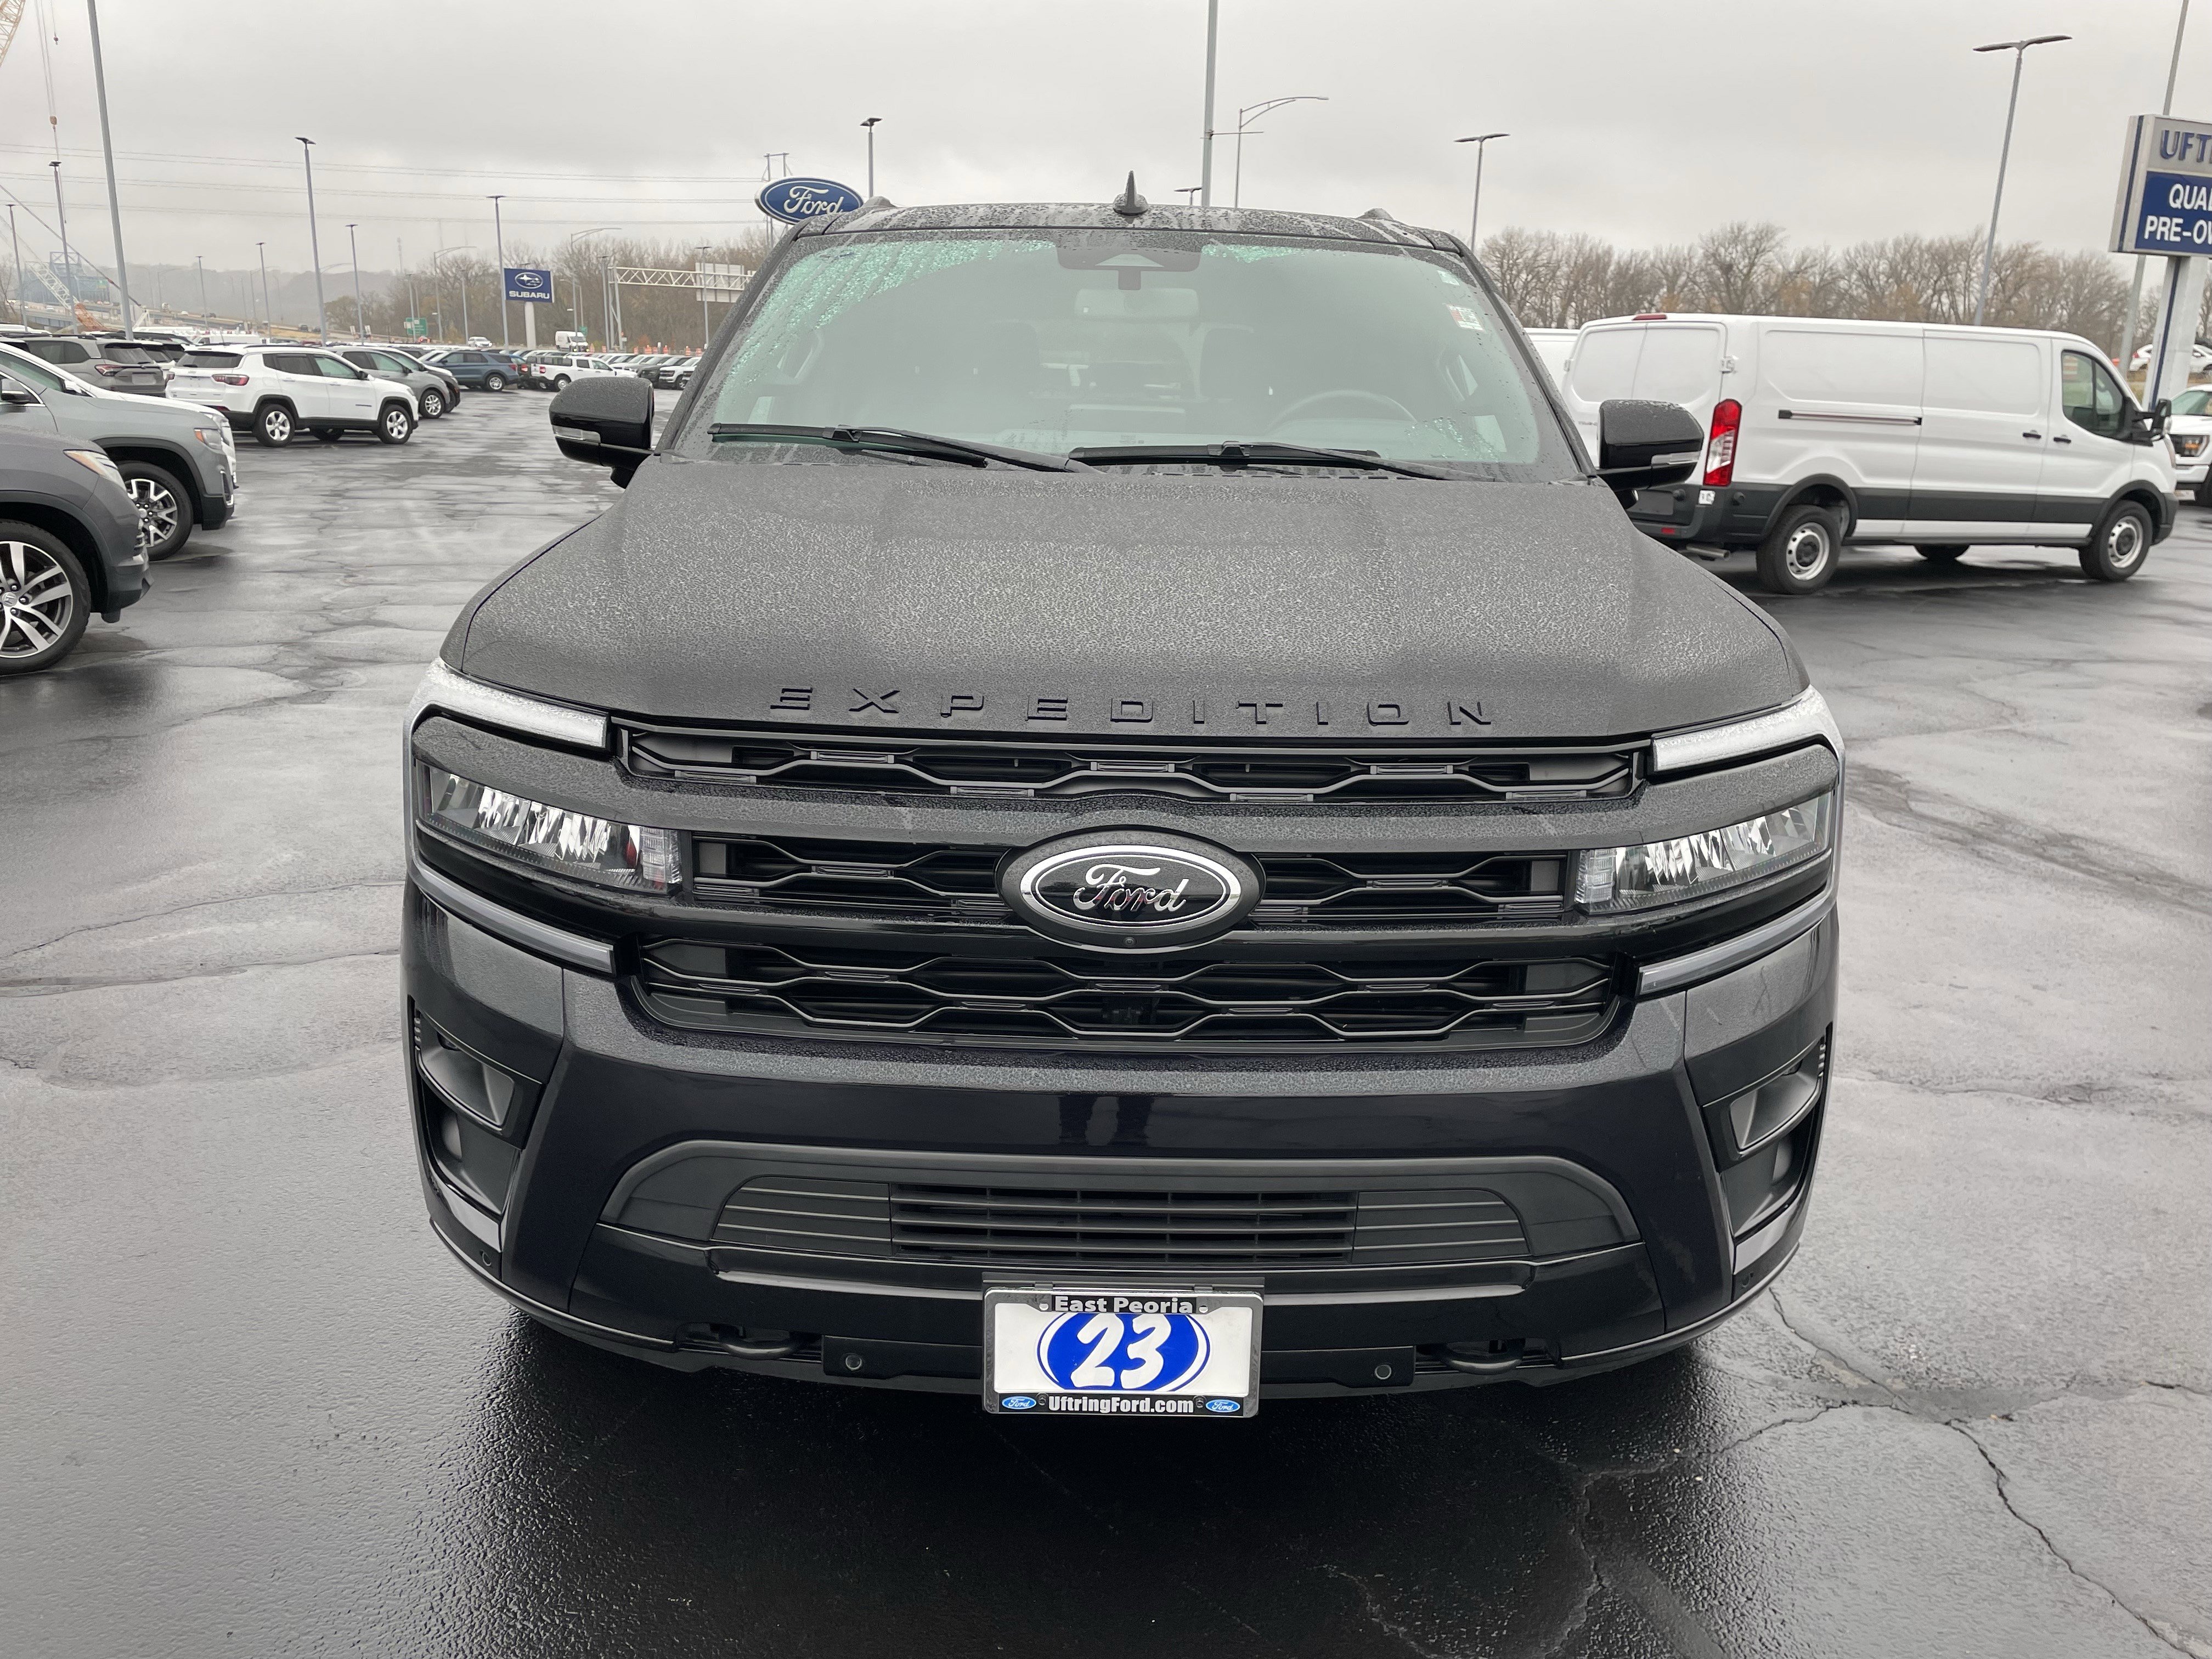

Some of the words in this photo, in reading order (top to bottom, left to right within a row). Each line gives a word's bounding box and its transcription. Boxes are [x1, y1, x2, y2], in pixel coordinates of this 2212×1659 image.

[2160, 129, 2212, 163] UFT
[783, 185, 844, 215] Ford
[2144, 215, 2212, 245] PRE-O
[509, 290, 550, 299] SUBARU
[770, 686, 1492, 726] EXPEDITION
[1073, 863, 1187, 912] Ford
[1055, 1296, 1107, 1313] East
[1113, 1297, 1193, 1314] Peoria
[1070, 1312, 1172, 1389] 23
[1008, 1397, 1030, 1407] Ford
[1048, 1396, 1194, 1413] UftringFord.com
[1211, 1401, 1234, 1410] Ford
